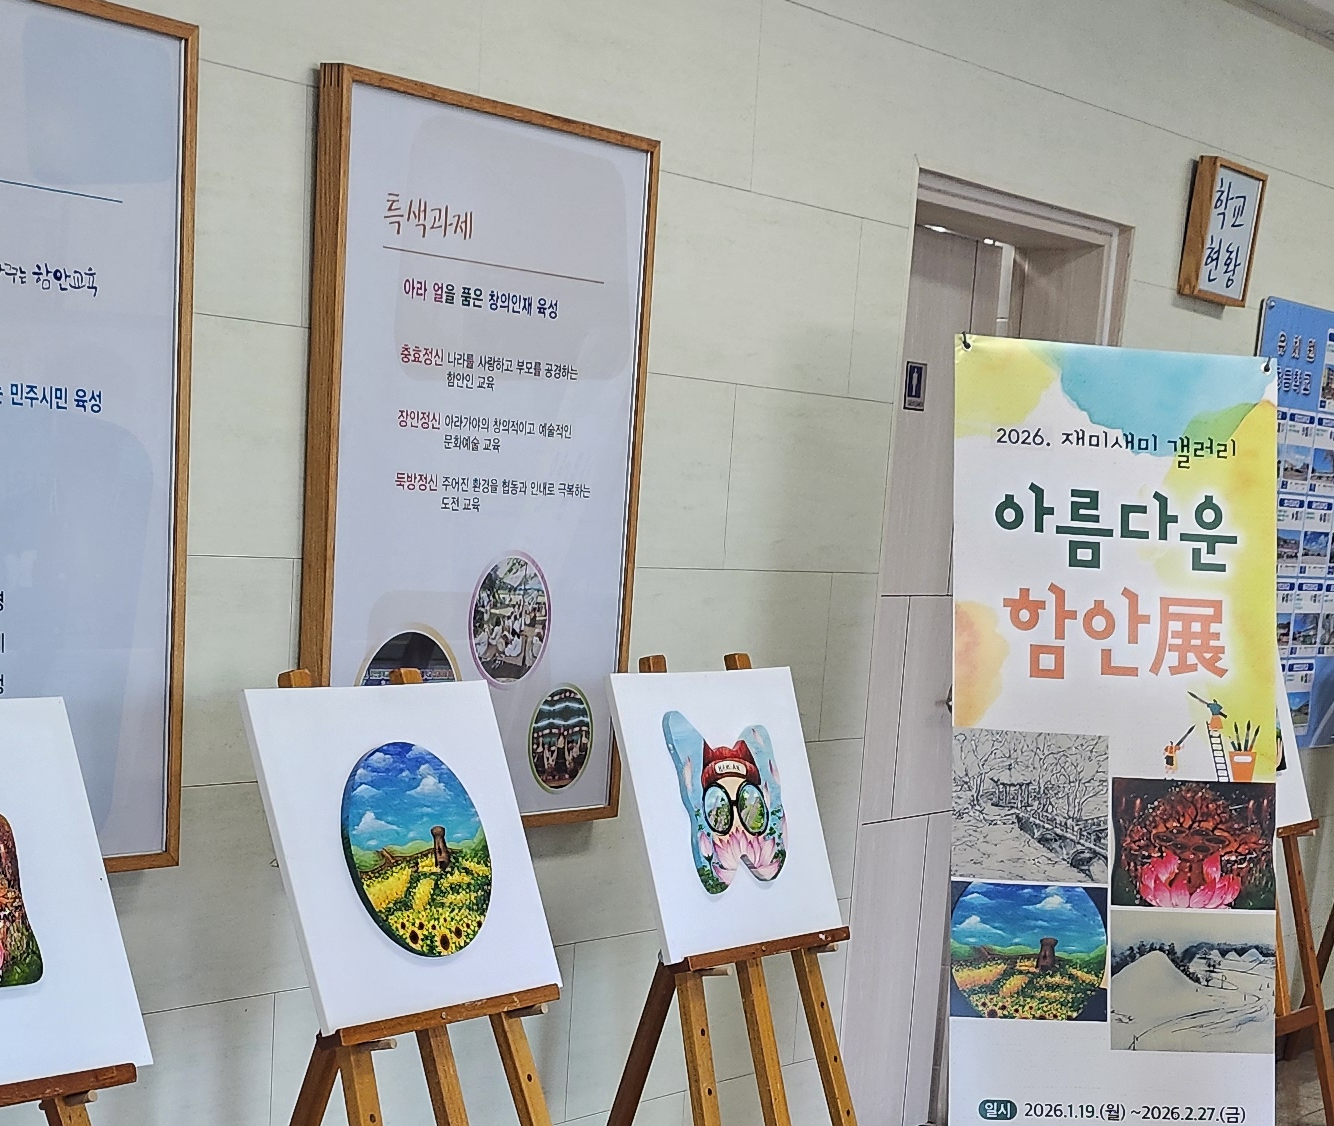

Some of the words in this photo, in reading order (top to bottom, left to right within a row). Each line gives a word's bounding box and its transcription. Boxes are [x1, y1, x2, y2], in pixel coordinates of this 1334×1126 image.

[383, 193, 474, 241] 특색과제
[1214, 177, 1247, 230] 학교
[1204, 235, 1242, 289] 현황
[404, 278, 427, 302] 아라
[432, 282, 455, 305] 얼을
[461, 286, 484, 308] 품은
[488, 290, 533, 316] 창의인재
[537, 298, 558, 320] 육성
[400, 344, 444, 367] 충효정신
[447, 351, 474, 370] 나라를
[477, 355, 513, 374] 사랑하고
[544, 363, 578, 381] 공경하는
[9, 383, 69, 411] 민주시민
[73, 388, 103, 414] 육성
[477, 375, 495, 391] 교육
[397, 410, 441, 430] 장인정신
[444, 414, 490, 433] 아라가야의
[493, 418, 535, 436] 창의적이고
[443, 435, 480, 452] 문화예술
[483, 437, 501, 453] 교육
[996, 428, 1051, 447] 2026.
[1062, 429, 1158, 452] 재미새미
[1168, 436, 1236, 470] 갤러리
[442, 476, 469, 492] 주어진
[472, 477, 498, 494] 환경을
[441, 496, 460, 511] 도전
[463, 497, 481, 512] 교육
[994, 481, 1238, 573] 아름다운
[1002, 582, 1229, 679] 함안展
[984, 1101, 1011, 1118] 일시
[1024, 1102, 1126, 1122] 2026.1.19.(월)
